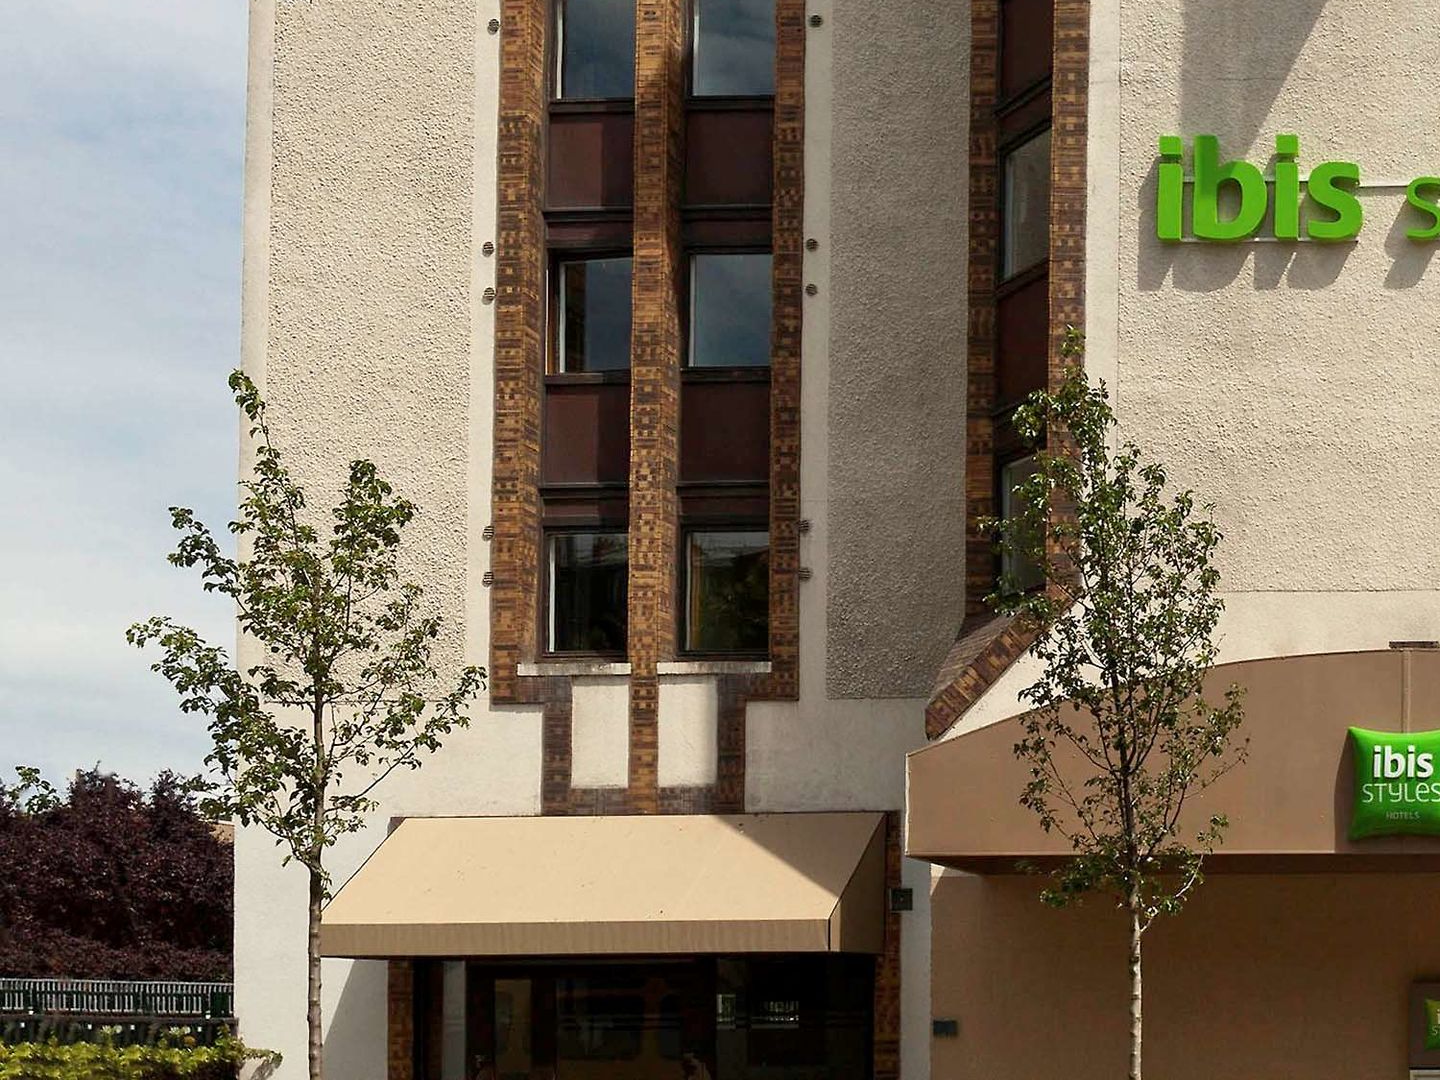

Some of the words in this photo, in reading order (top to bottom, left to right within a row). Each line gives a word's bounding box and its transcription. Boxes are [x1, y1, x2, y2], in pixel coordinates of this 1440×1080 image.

[1156, 133, 1364, 242] ibis
[1373, 745, 1434, 778] ibis
[1386, 811, 1420, 820] HOTELS
